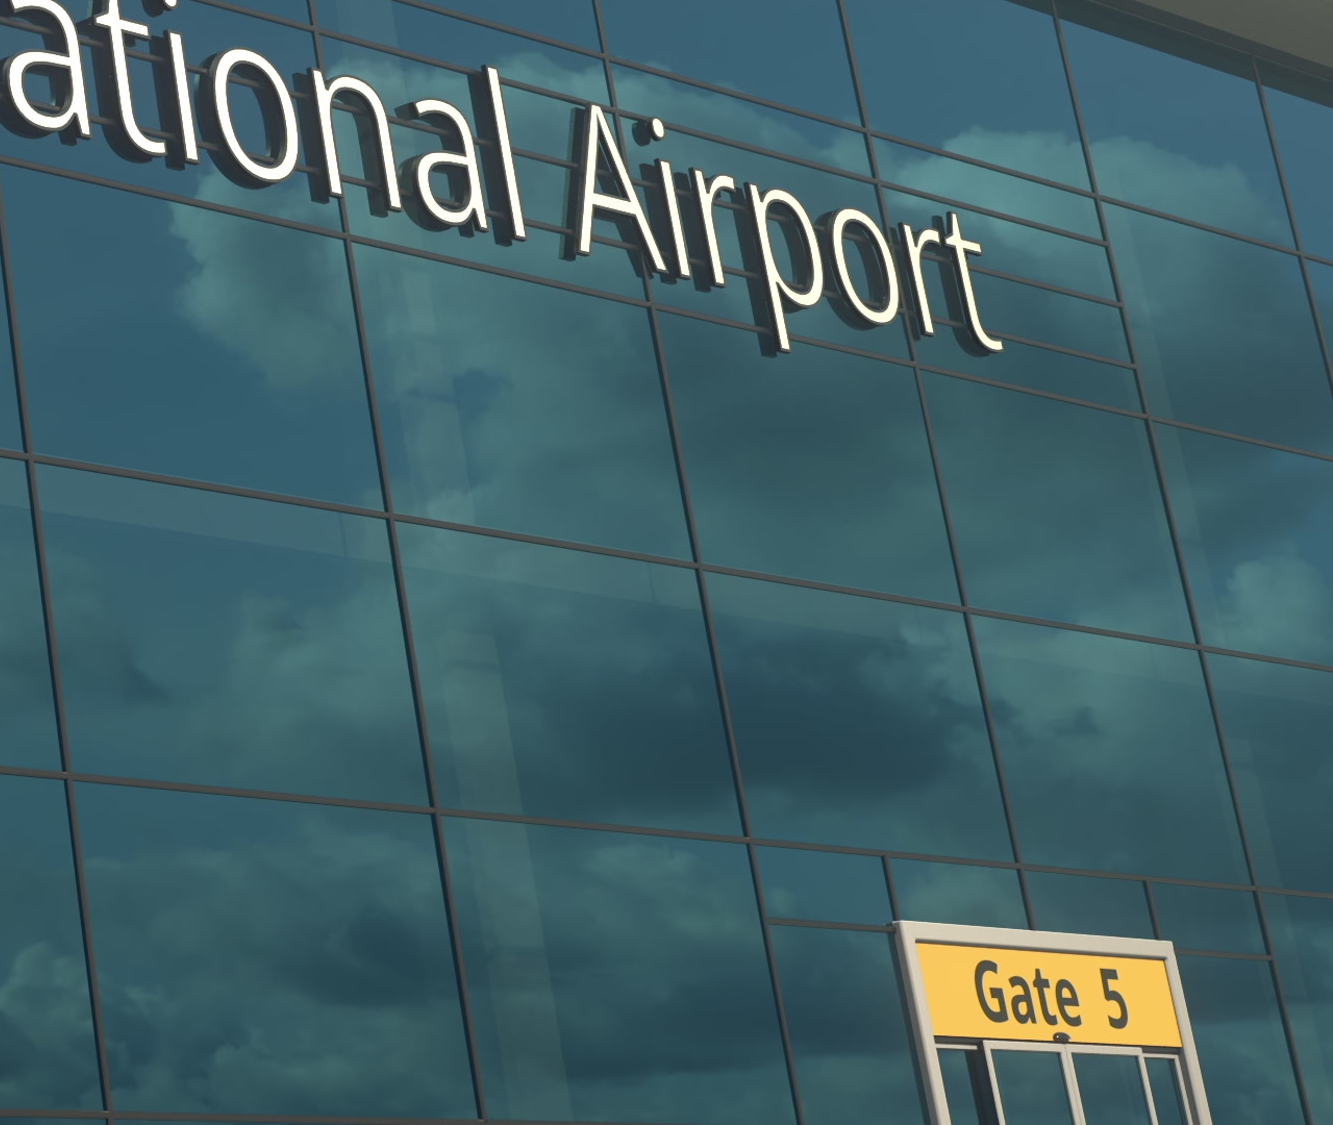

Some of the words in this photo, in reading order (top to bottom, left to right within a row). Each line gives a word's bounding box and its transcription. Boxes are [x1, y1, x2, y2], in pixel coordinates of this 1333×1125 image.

[577, 103, 1004, 353] Airport
[974, 959, 1082, 1027] Gate
[1099, 968, 1129, 1030] 5
